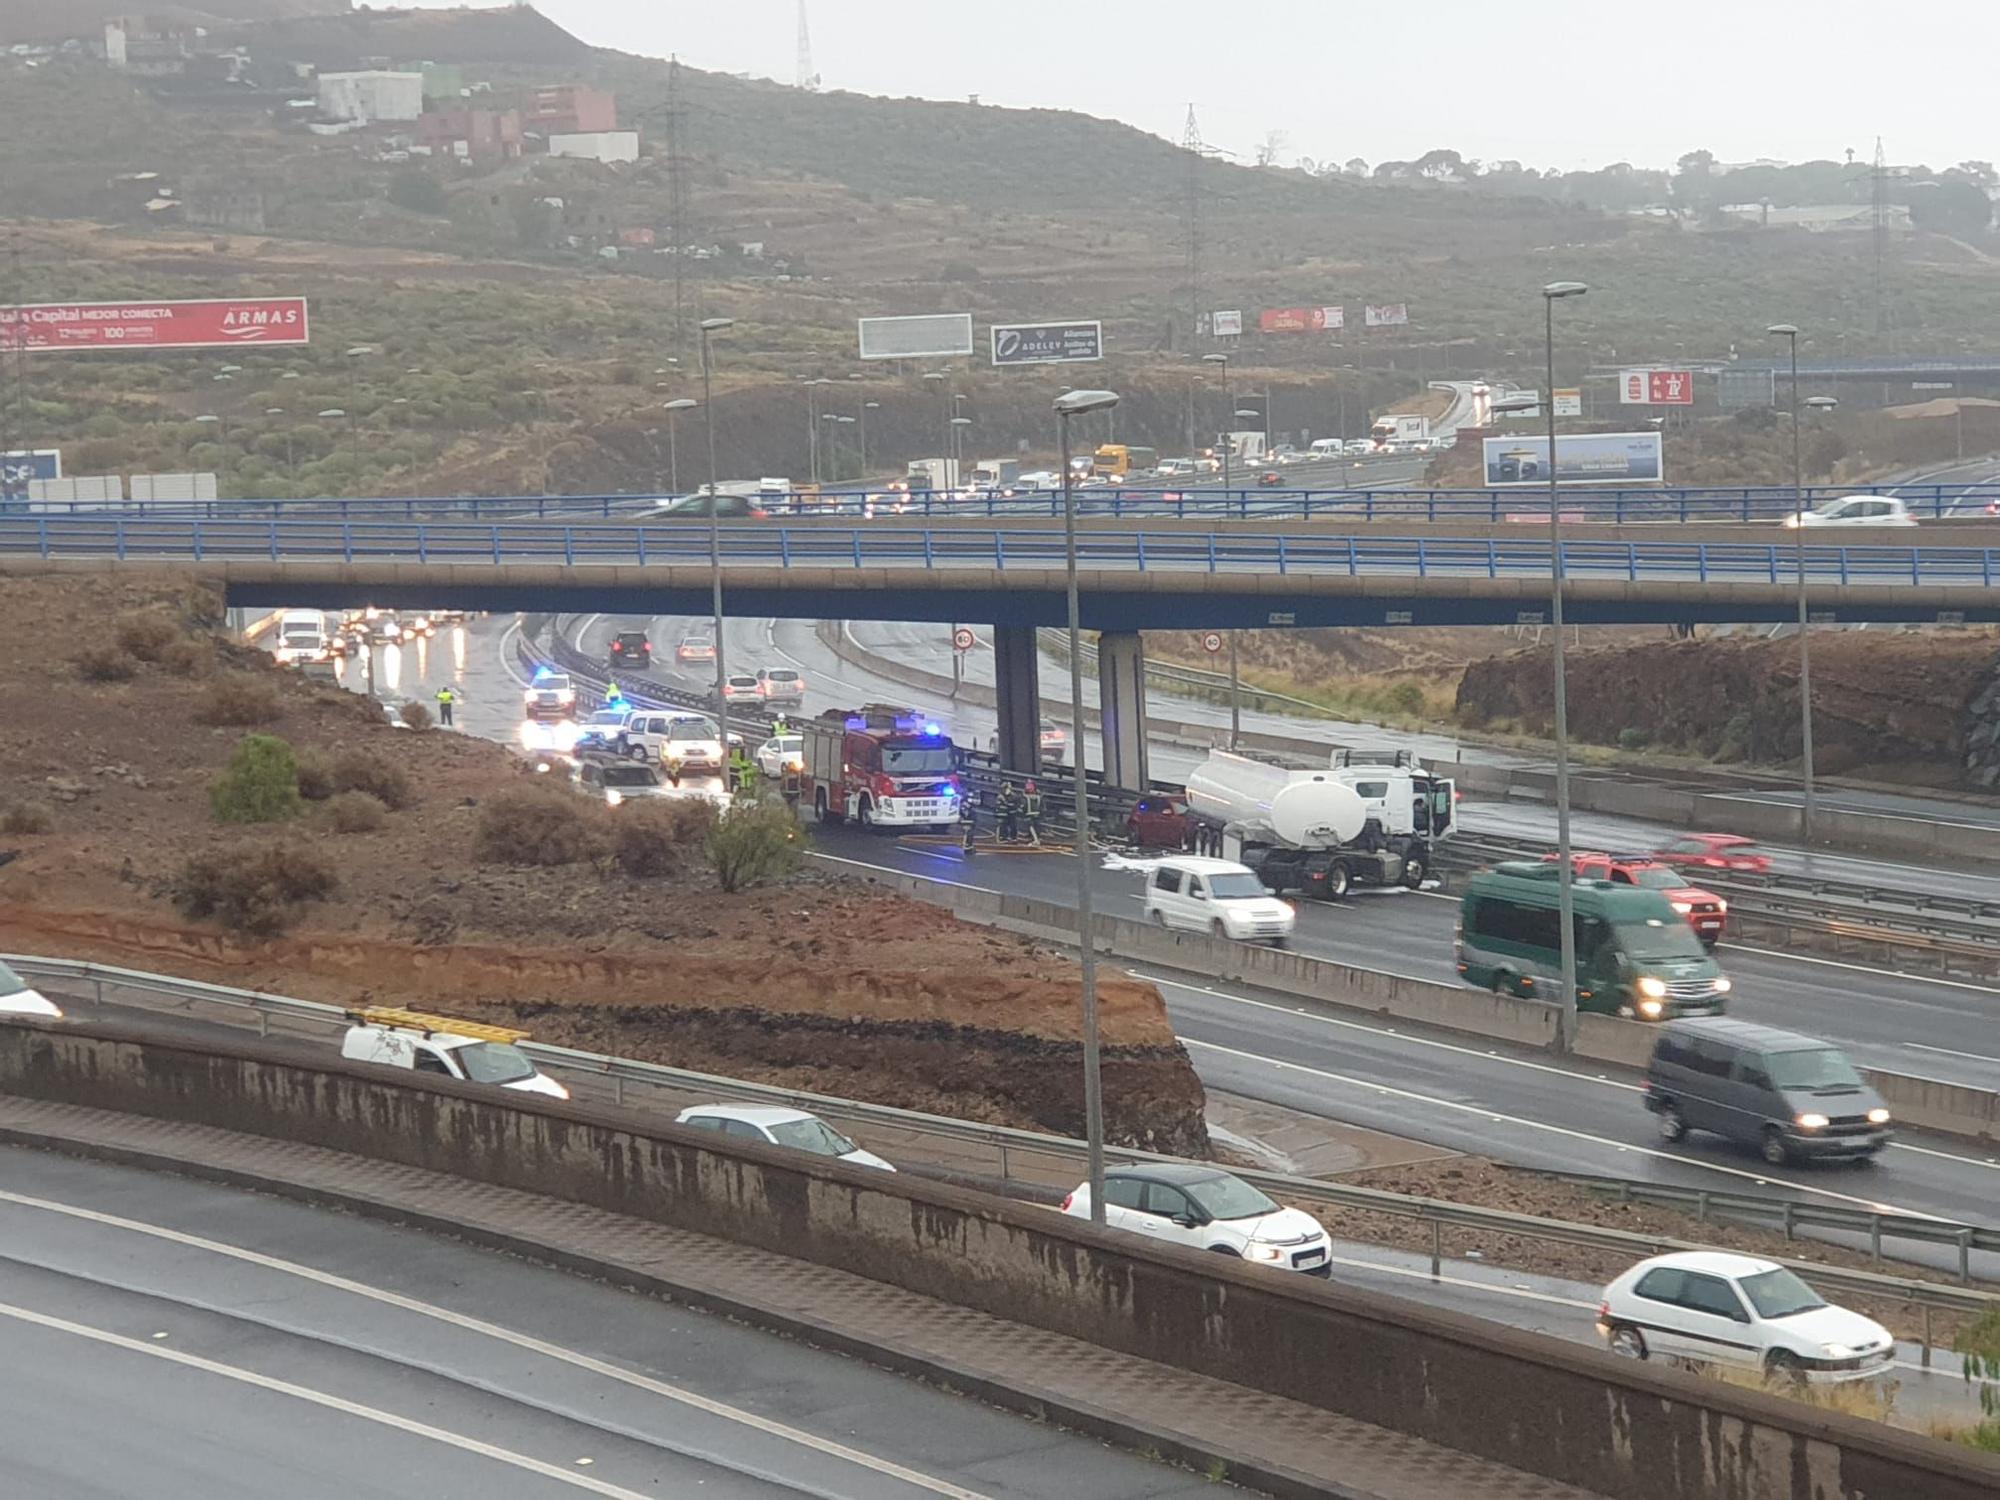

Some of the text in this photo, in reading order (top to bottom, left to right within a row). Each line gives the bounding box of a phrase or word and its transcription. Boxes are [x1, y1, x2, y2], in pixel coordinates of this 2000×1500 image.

[32, 308, 80, 323] Capital
[224, 310, 297, 325] ARMAS
[103, 326, 125, 338] 100
